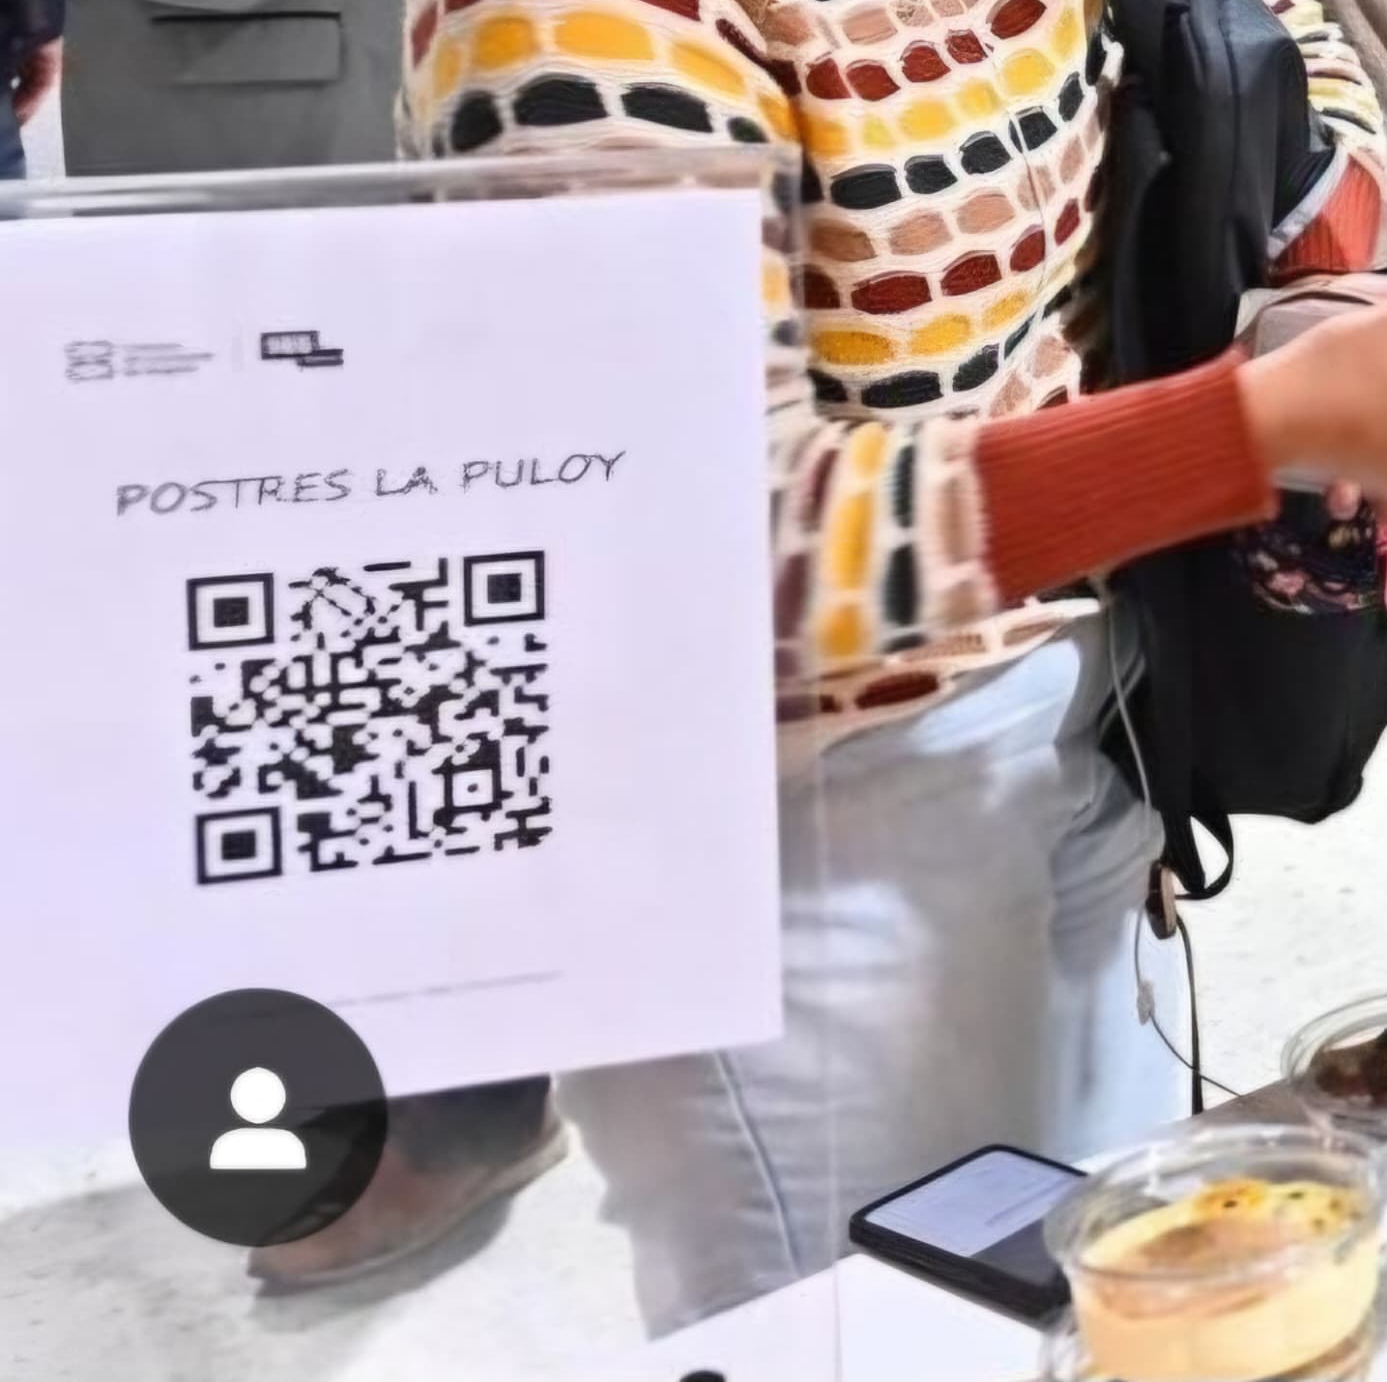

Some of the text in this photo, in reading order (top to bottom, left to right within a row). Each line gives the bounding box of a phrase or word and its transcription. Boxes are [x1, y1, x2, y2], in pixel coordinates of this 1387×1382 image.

[116, 449, 627, 516] POSTRES LA PULOY
